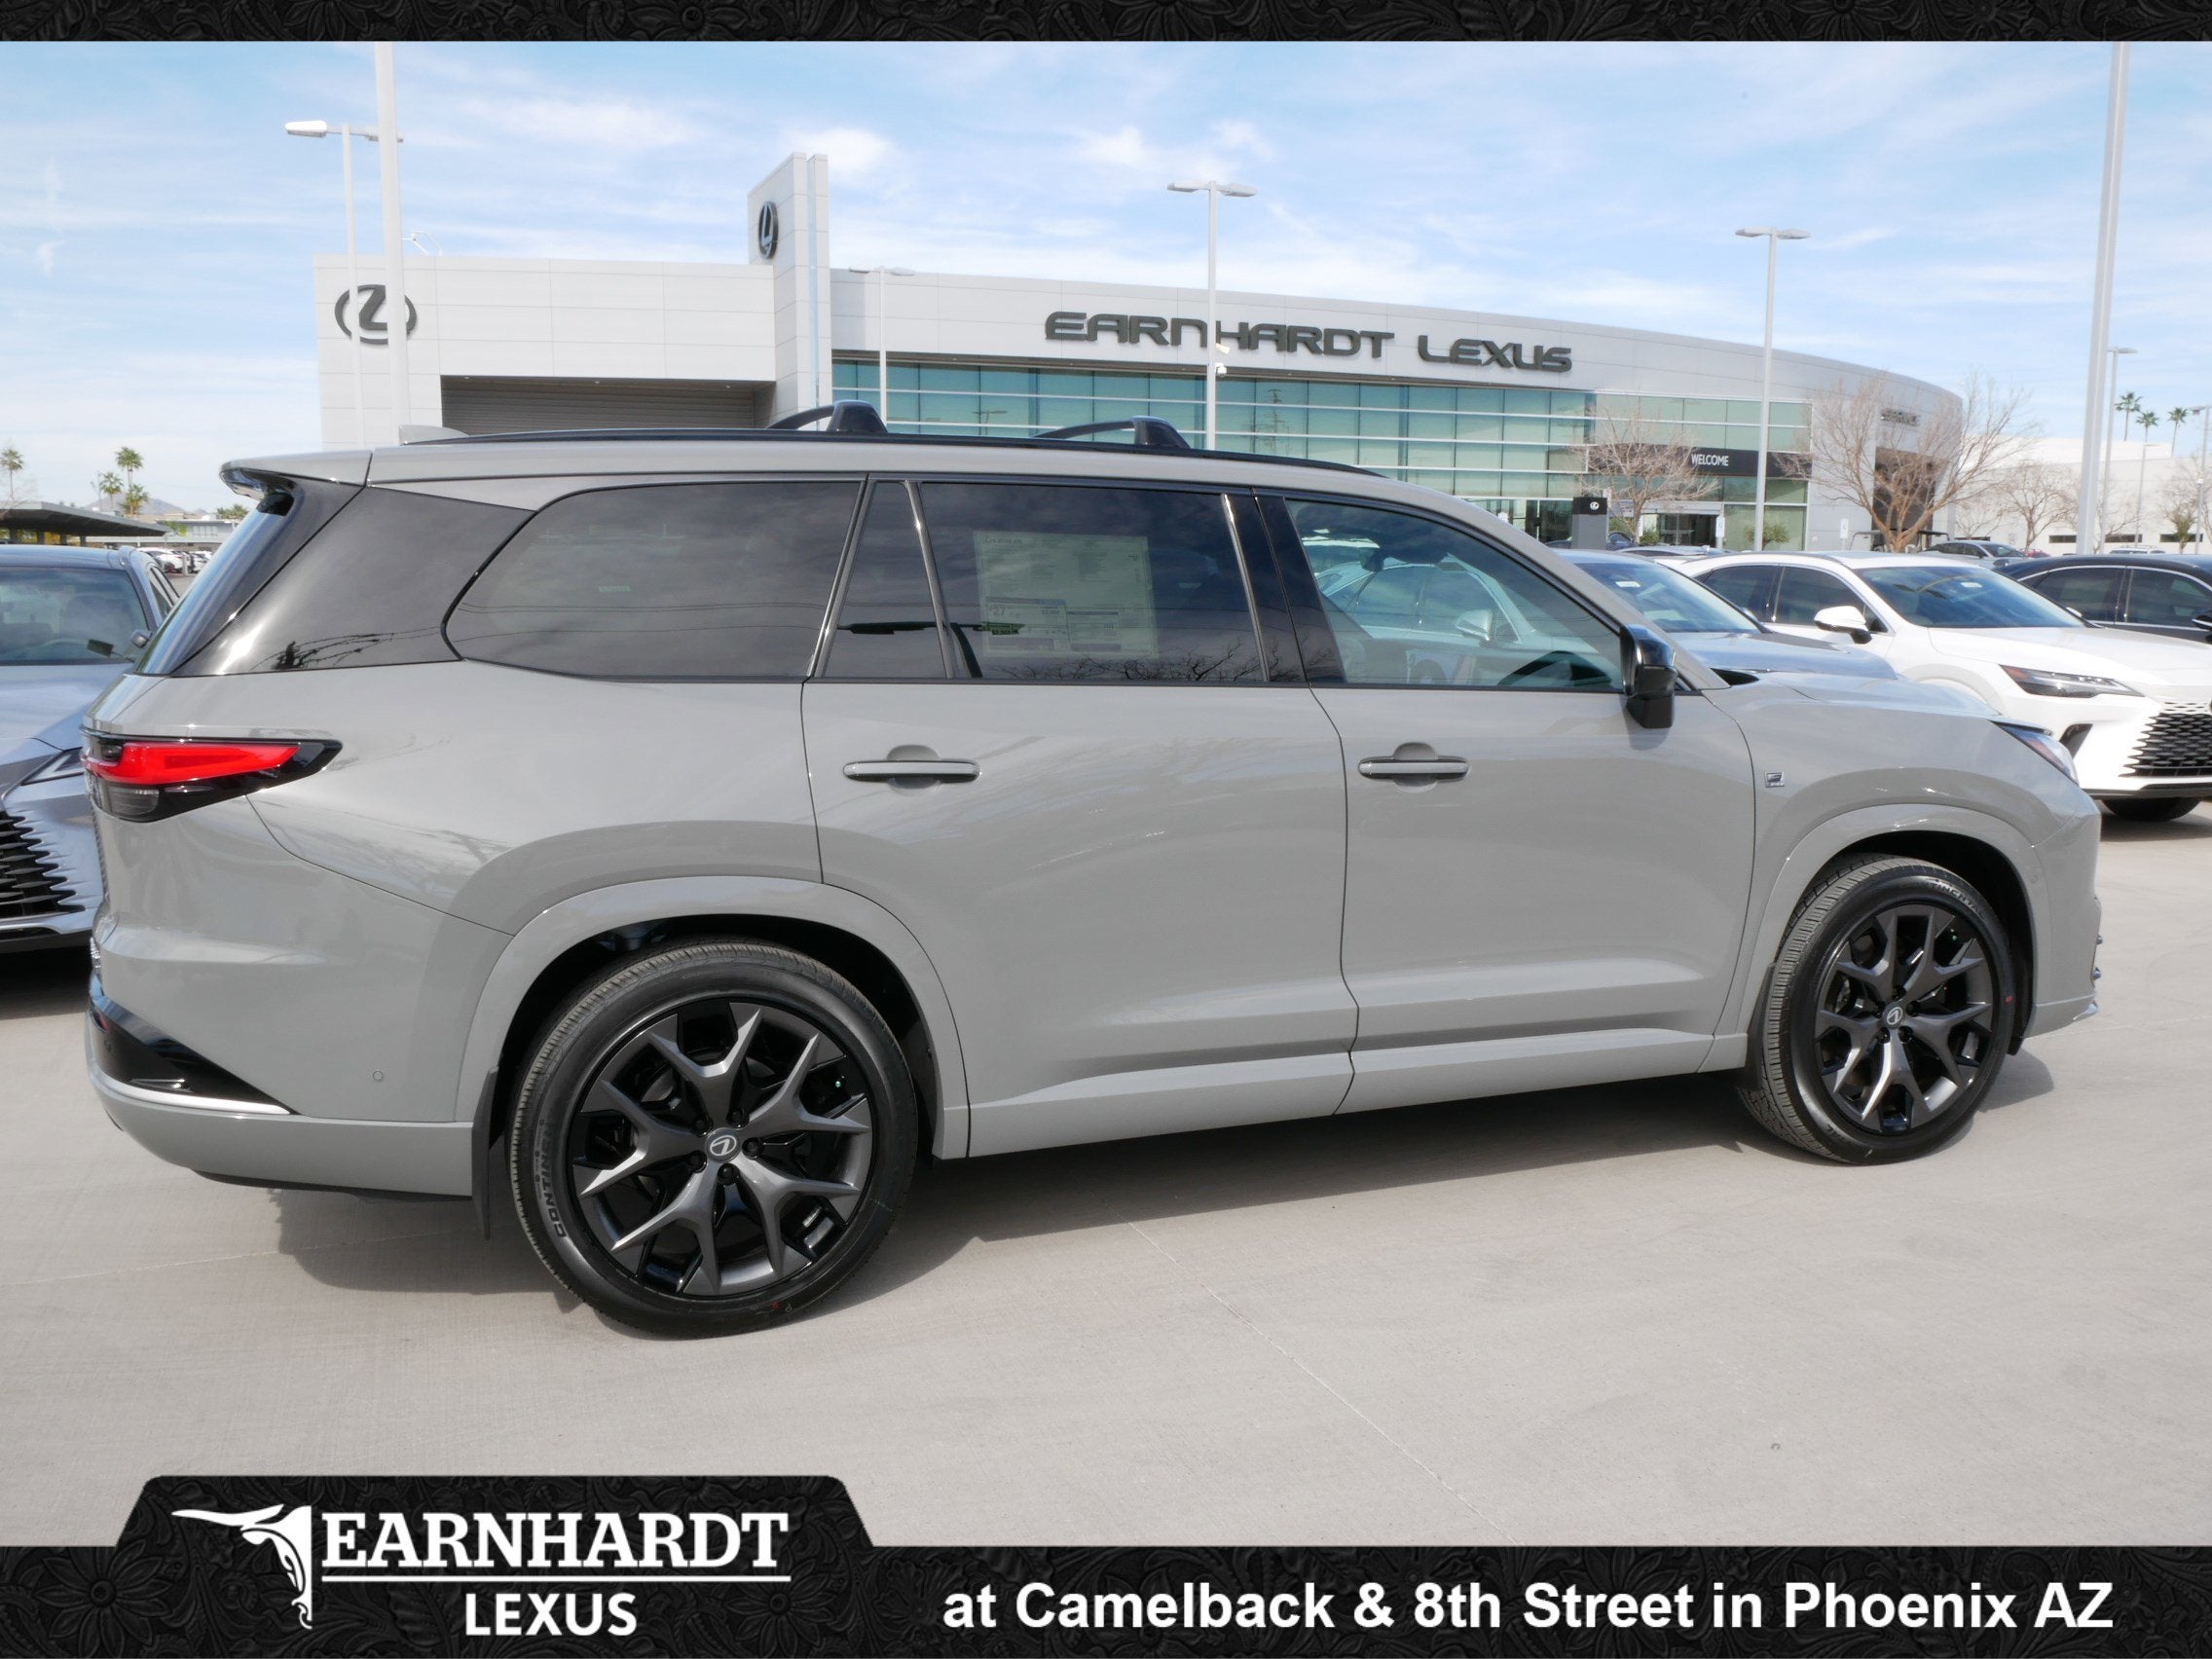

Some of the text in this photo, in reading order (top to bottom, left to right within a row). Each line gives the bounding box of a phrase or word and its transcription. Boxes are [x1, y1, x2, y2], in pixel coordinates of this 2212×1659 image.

[1045, 311, 1573, 373] EARNHARDT LEXUS
[1691, 453, 1729, 466] WELCOME
